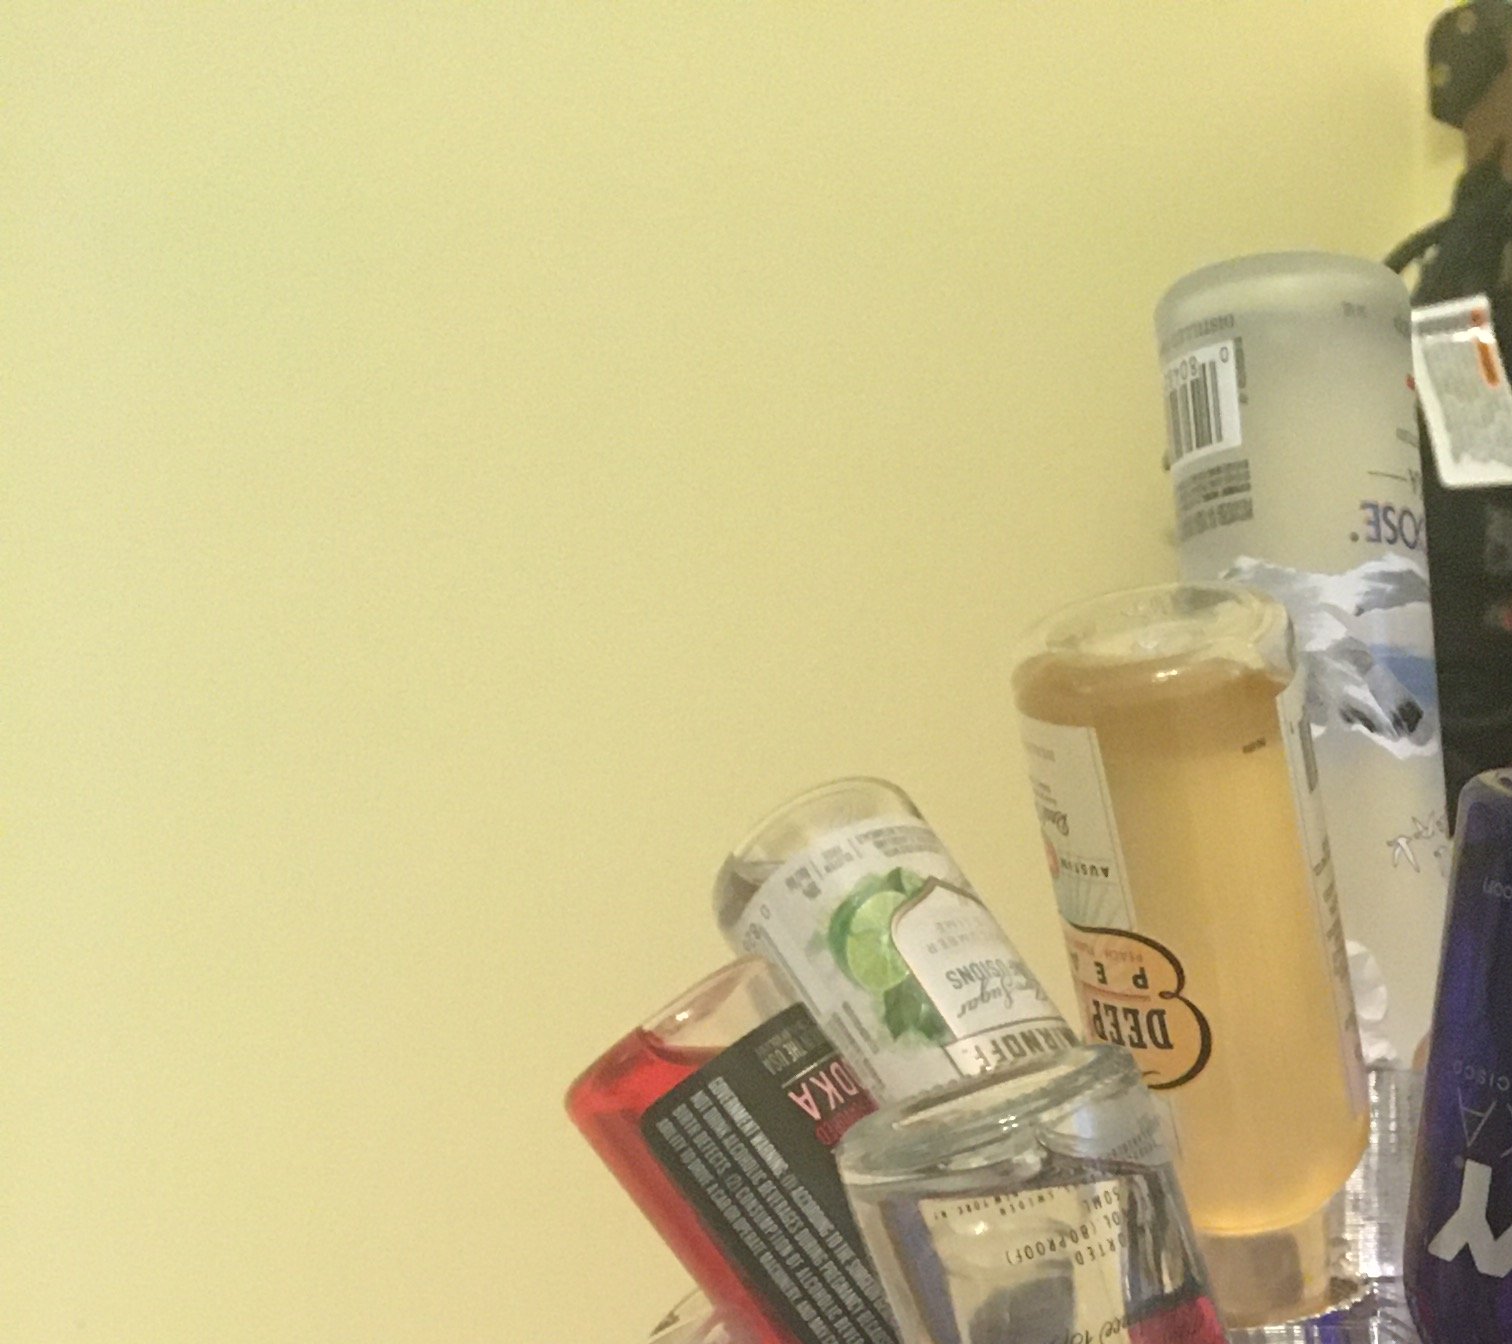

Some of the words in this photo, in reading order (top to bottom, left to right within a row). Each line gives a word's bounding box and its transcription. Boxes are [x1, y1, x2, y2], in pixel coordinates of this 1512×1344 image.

[1360, 501, 1425, 550] OSE
[974, 1028, 1075, 1069] IRNOFF
[1093, 1000, 1173, 1050] DEEP
[787, 1060, 860, 1121] DKA
[1074, 1233, 1125, 1266] ORTED
